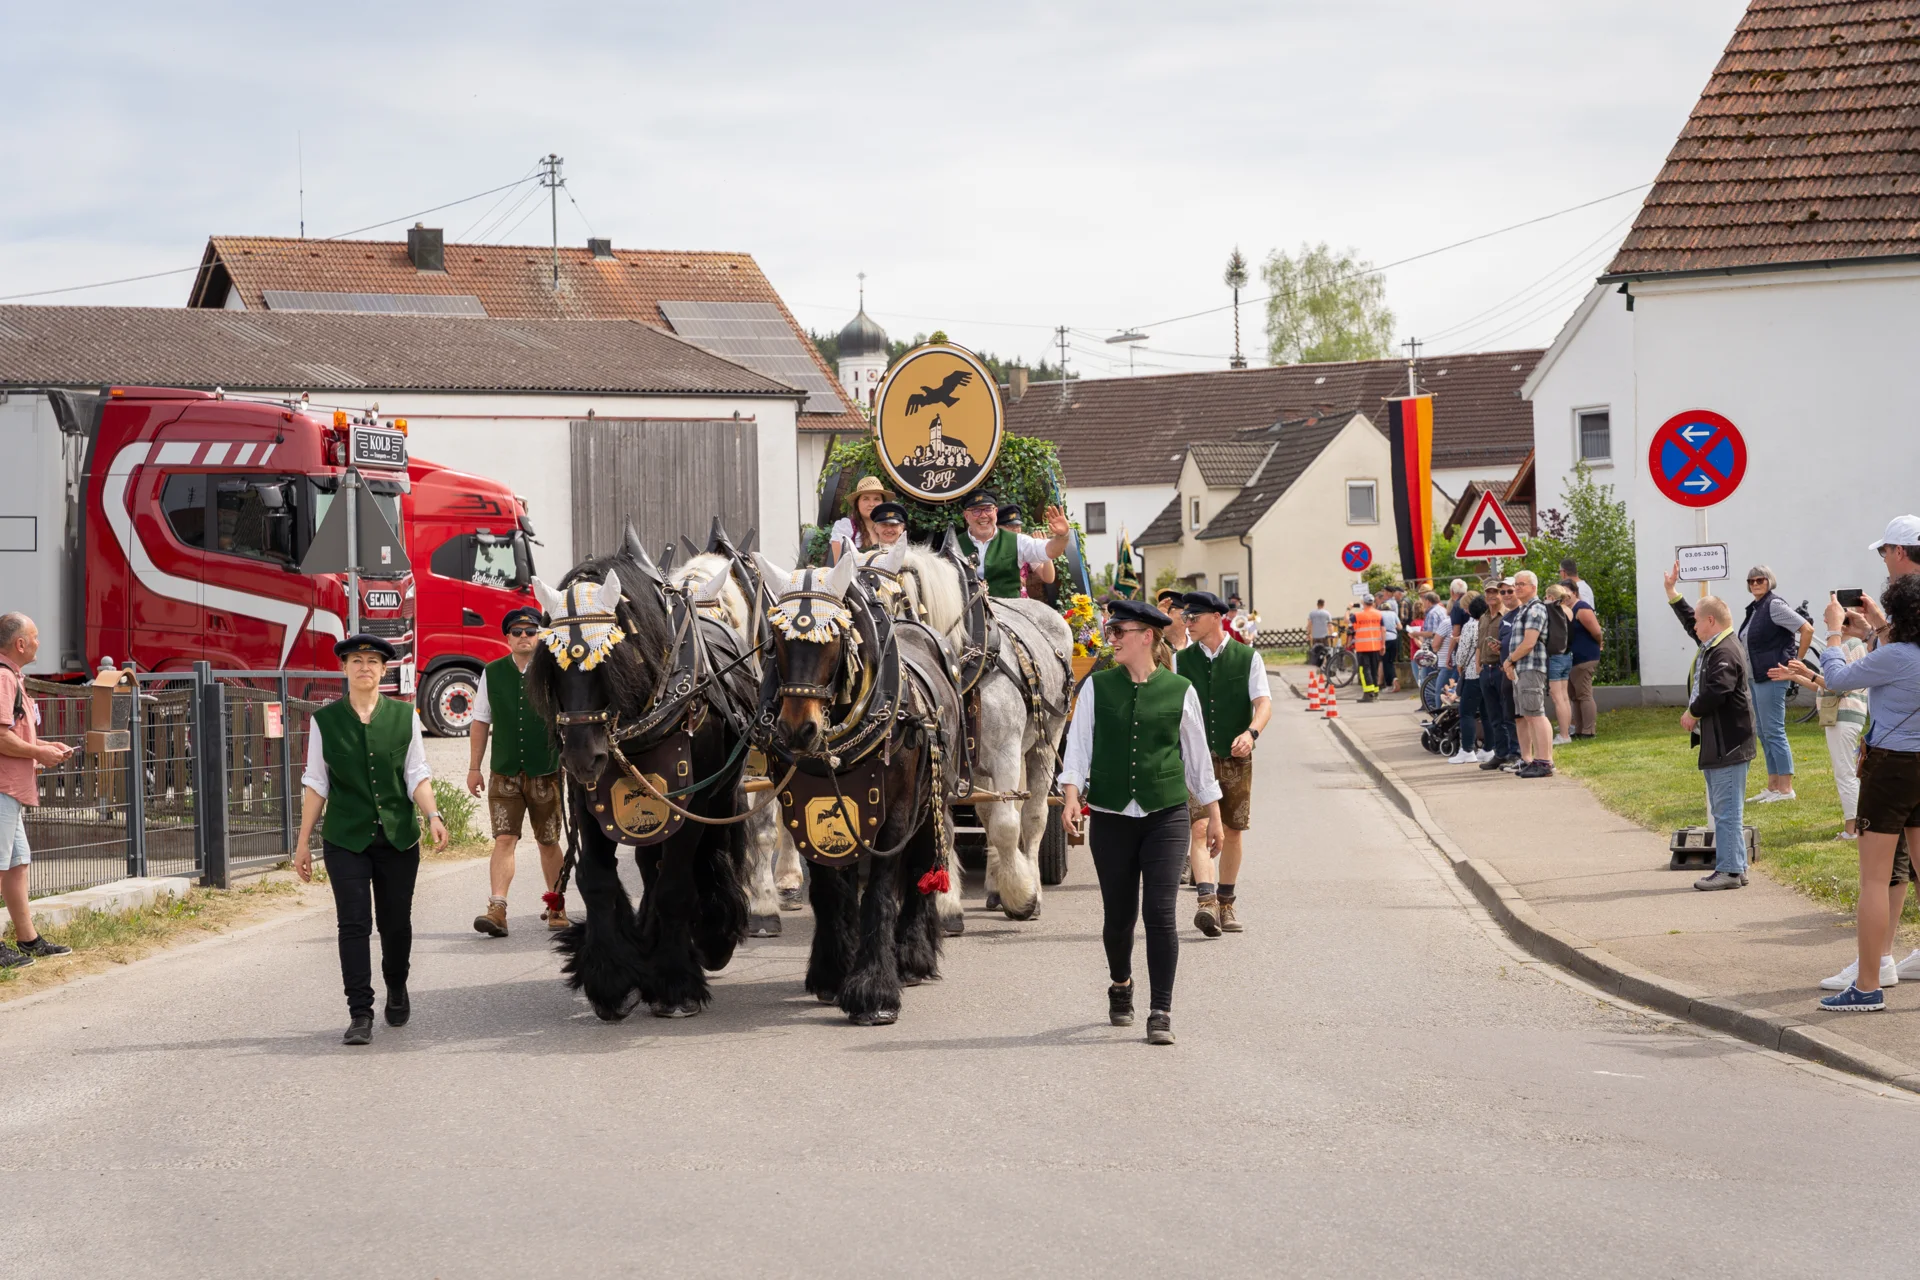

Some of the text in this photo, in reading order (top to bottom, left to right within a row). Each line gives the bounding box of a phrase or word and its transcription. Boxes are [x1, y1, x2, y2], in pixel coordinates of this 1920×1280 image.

[370, 435, 391, 451] KOLB
[920, 469, 956, 491] Berg
[369, 593, 398, 606] SCANIA
[403, 668, 412, 689] A
